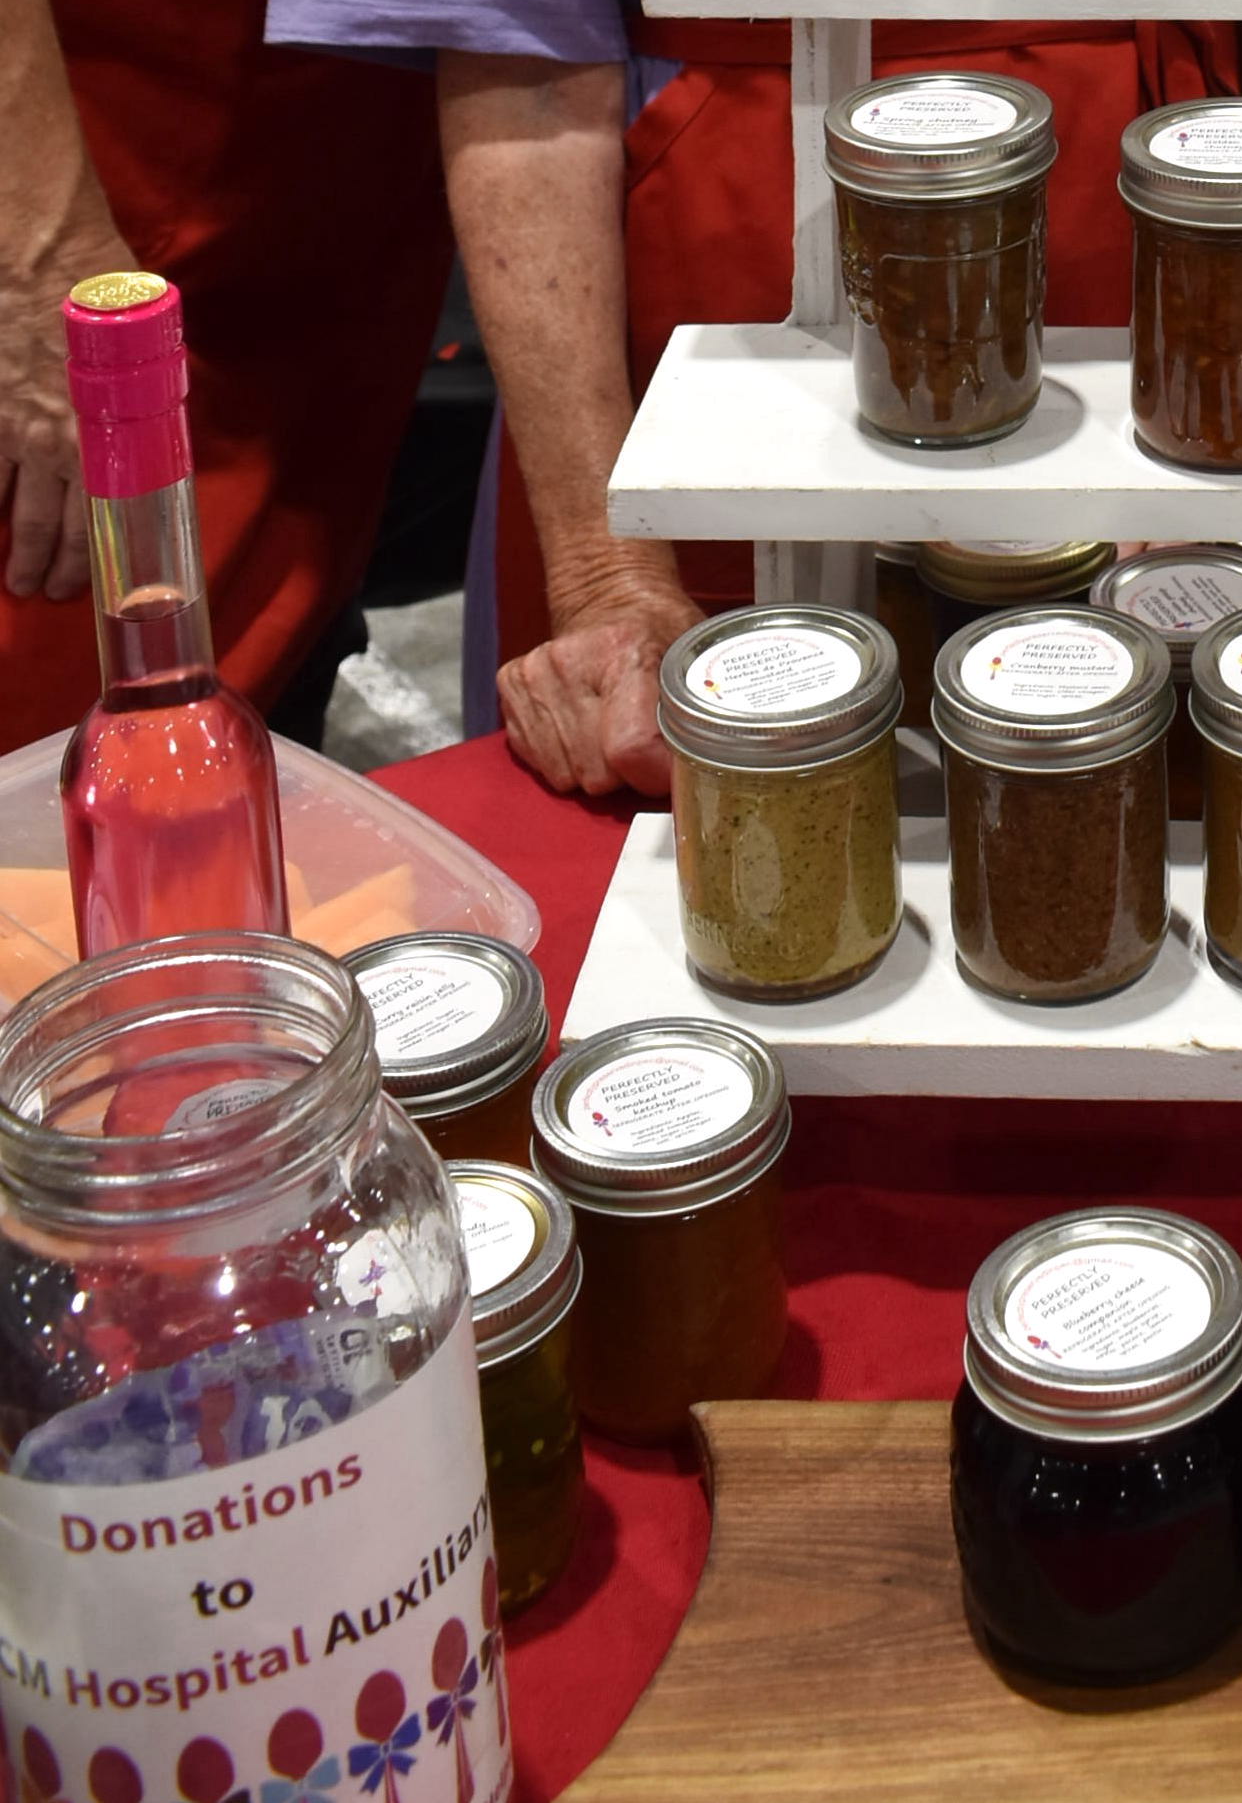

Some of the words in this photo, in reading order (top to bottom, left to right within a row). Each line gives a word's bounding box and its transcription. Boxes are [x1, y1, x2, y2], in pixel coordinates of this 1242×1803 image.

[722, 642, 790, 665] PERFECTLY
[726, 650, 797, 672] PRESERVED
[1022, 651, 1098, 660] PRESERVED
[1025, 643, 1098, 652] PERFECTLY
[1010, 662, 1065, 672] Cranberry
[367, 973, 415, 1001] RFECTLY
[371, 979, 424, 1010] ESERVED
[406, 994, 434, 1012] raisin
[435, 982, 456, 997] jelly
[601, 1065, 674, 1094] PERFECTLY
[605, 1074, 680, 1103] PRESERVED
[614, 1094, 657, 1112] Smoked
[662, 1080, 701, 1098] tomato
[633, 1097, 676, 1116] ketchup
[1032, 1265, 1099, 1311] PERFECTLY
[1041, 1273, 1111, 1320] PRESERVED
[1063, 1297, 1115, 1330] Blueberry
[1115, 1276, 1146, 1300] cheese
[1078, 1299, 1133, 1335] companion
[60, 1453, 363, 1554] Donations
[191, 1578, 254, 1617] to
[0, 1636, 52, 1698] CM
[64, 1625, 311, 1713] Hospital
